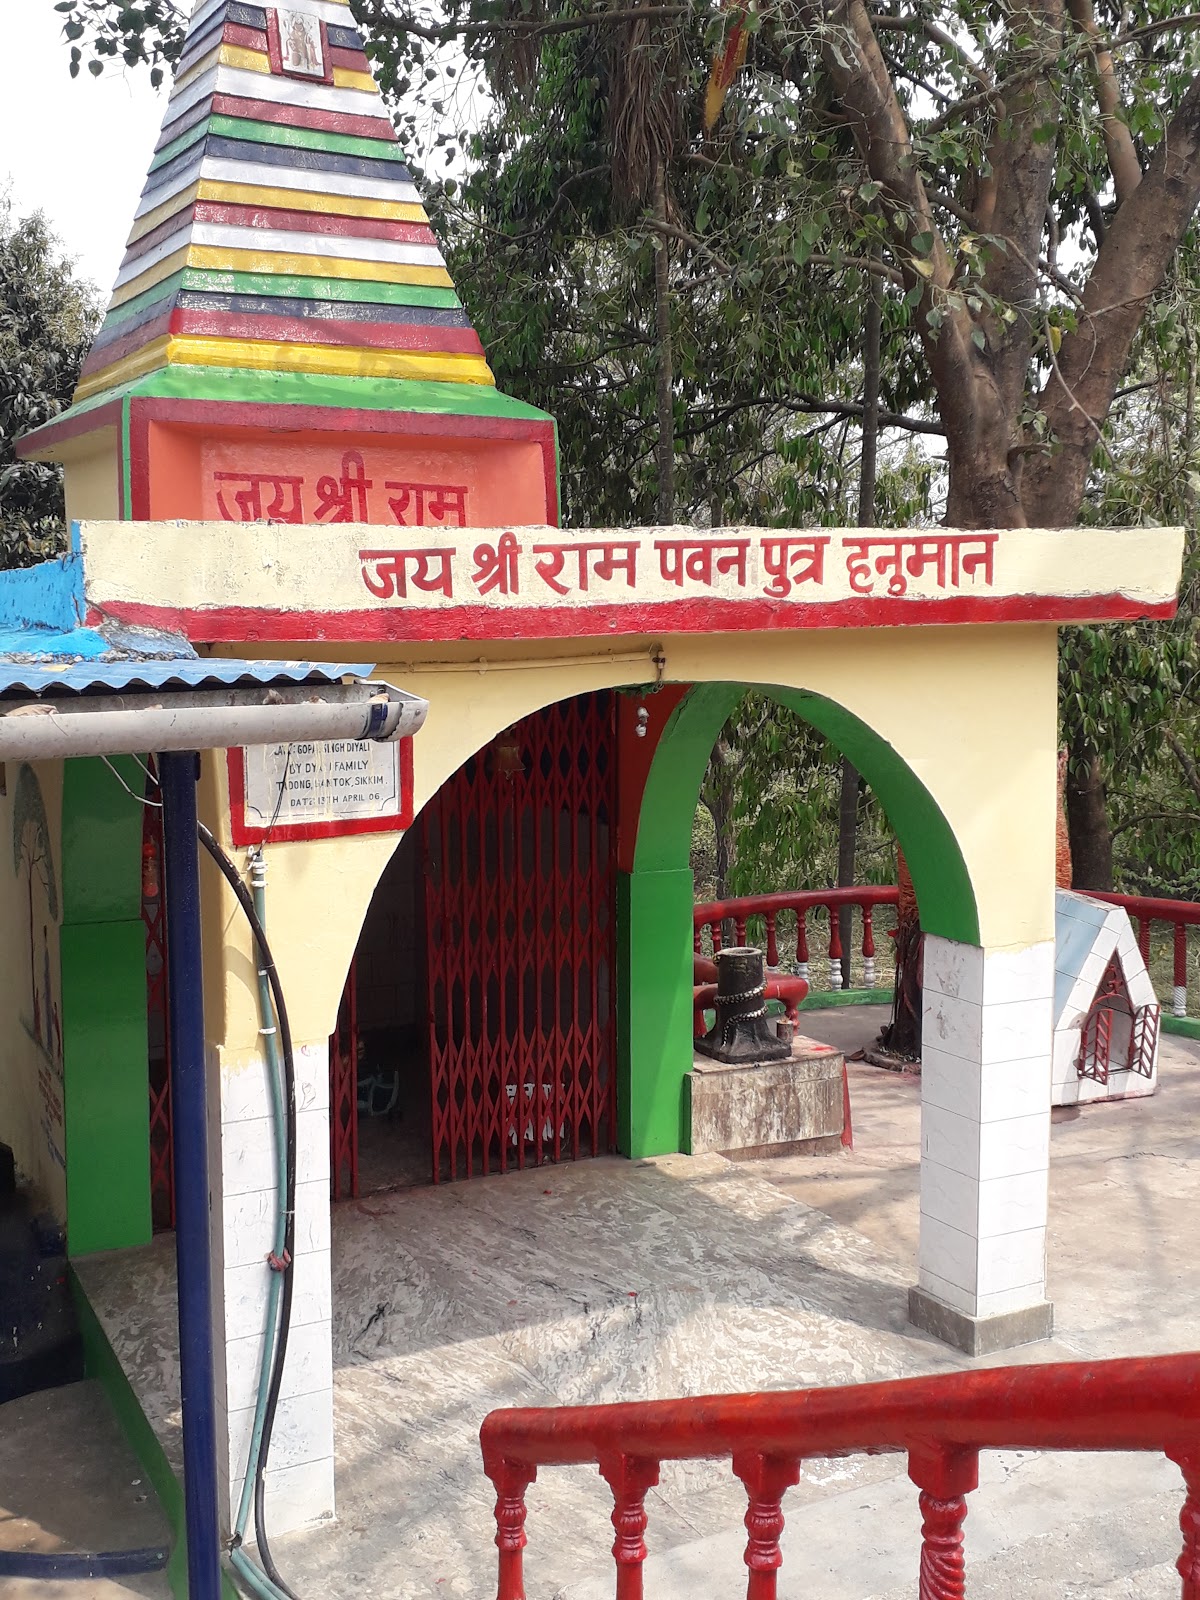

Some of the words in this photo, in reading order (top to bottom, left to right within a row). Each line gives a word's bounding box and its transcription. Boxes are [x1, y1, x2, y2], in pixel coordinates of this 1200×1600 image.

[213, 471, 304, 525] जय
[313, 450, 373, 524] श्री
[384, 480, 469, 528] राम
[358, 547, 457, 599] जय
[470, 531, 523, 596] श्री
[532, 540, 642, 596] राम
[653, 537, 751, 588] पवन
[759, 535, 832, 599] पुत्र
[841, 533, 1000, 597] हनुमान
[334, 760, 369, 772] FAMILY
[342, 794, 365, 803] APRIL
